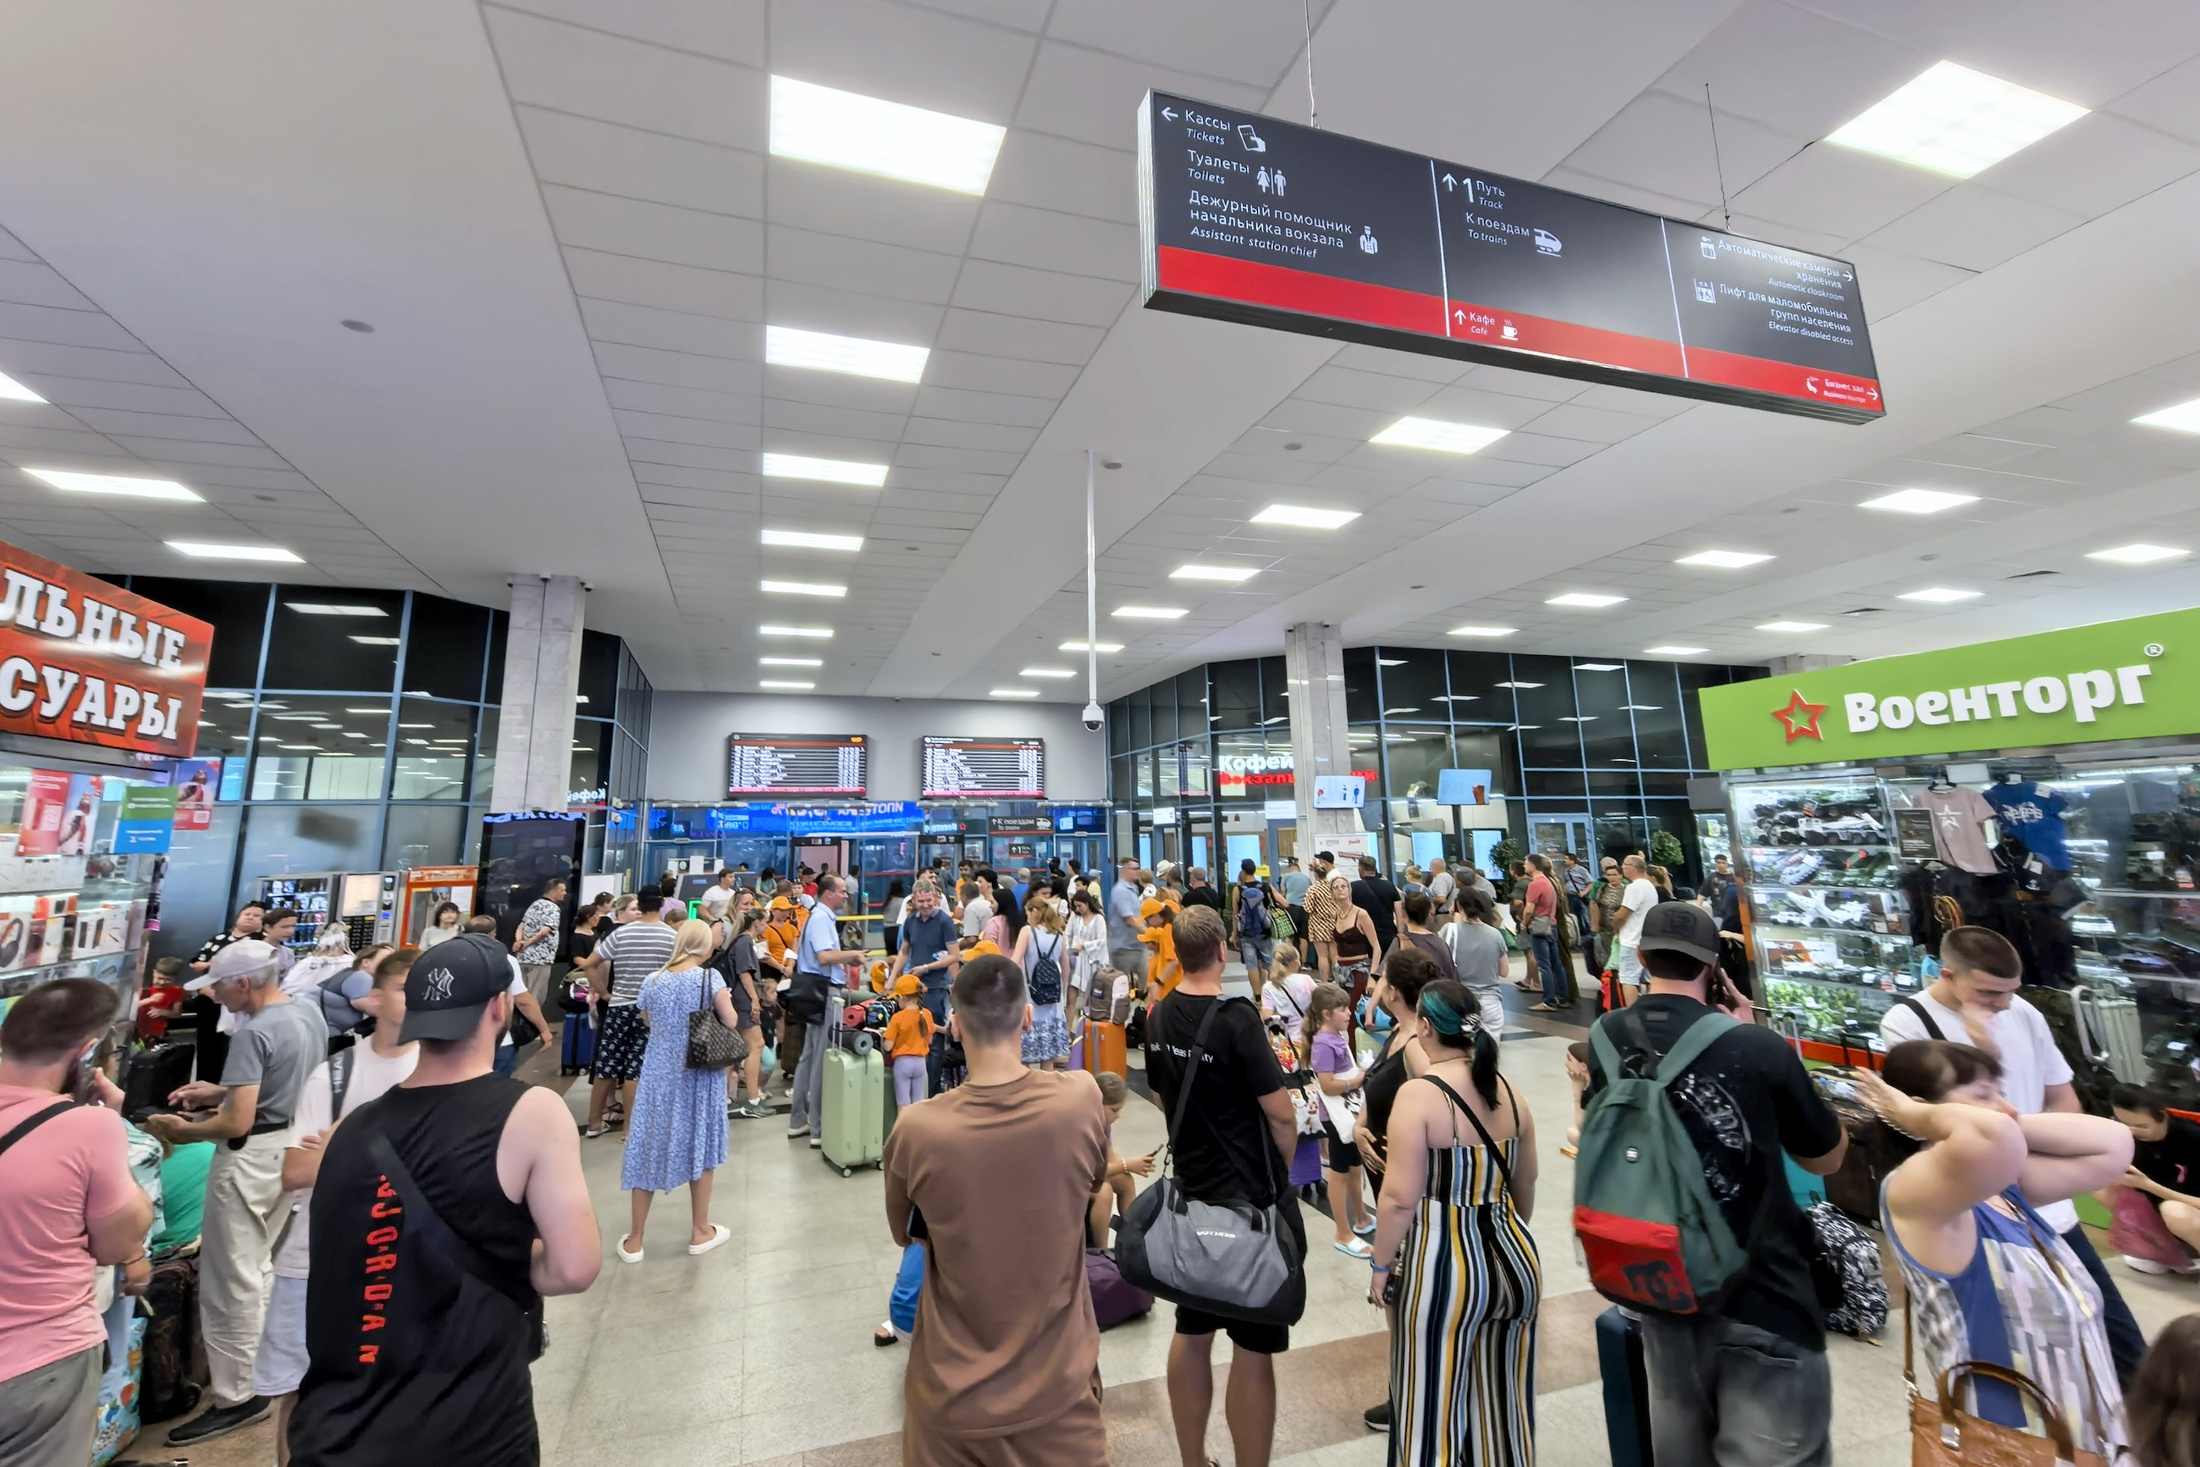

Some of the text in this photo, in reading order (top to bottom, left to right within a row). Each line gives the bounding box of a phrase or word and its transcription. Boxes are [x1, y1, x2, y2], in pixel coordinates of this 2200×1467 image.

[1185, 109, 1231, 131] Кассы
[1186, 127, 1225, 145] Tickets
[1187, 149, 1250, 174] Туалеты
[1188, 167, 1226, 185] Toilets
[1462, 177, 1506, 204] 1 Путь
[1478, 196, 1504, 210] Track
[1189, 189, 1353, 235] Дежурный помощник
[1465, 212, 1530, 237] К поездам
[1190, 209, 1344, 249] начальника вокзала
[1468, 228, 1508, 246] To trains
[1190, 226, 1318, 259] Assistant station chief
[1718, 240, 1841, 278] Автоматические камеры
[1768, 277, 1807, 294] Automatic
[1796, 271, 1843, 290] хранения
[1719, 283, 1849, 321] Лифт для маломобильных
[1469, 312, 1496, 326] Кафе
[1770, 308, 1852, 333] групп населения
[1768, 320, 1854, 346] Elevator disabled access
[1843, 664, 2152, 723] Военторг
[359, 1202, 402, 1364] JORDAN
